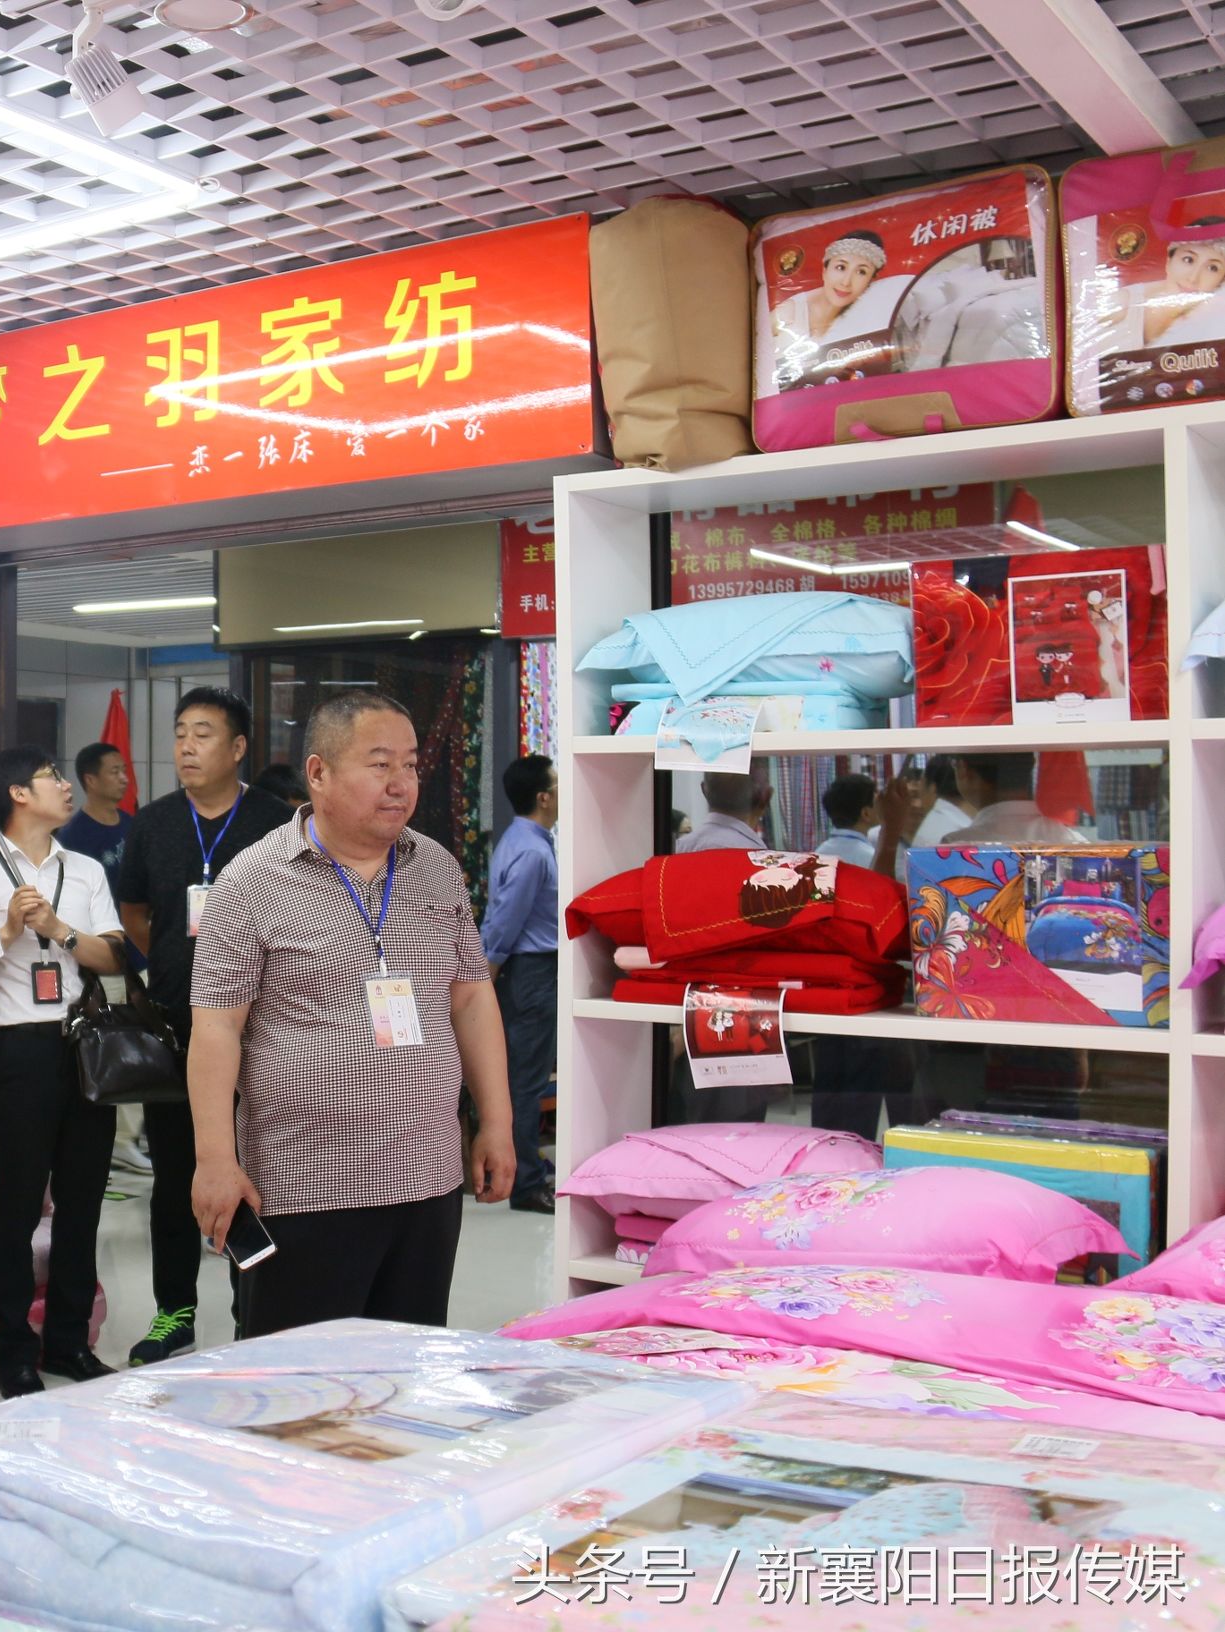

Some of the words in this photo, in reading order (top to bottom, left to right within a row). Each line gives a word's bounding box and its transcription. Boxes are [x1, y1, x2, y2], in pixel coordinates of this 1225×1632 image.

[909, 205, 997, 247] 休闲被
[1160, 348, 1219, 373] Quilt
[187, 429, 315, 478] 恋一张床
[522, 542, 556, 564] 主营
[688, 577, 795, 600] 13995729468
